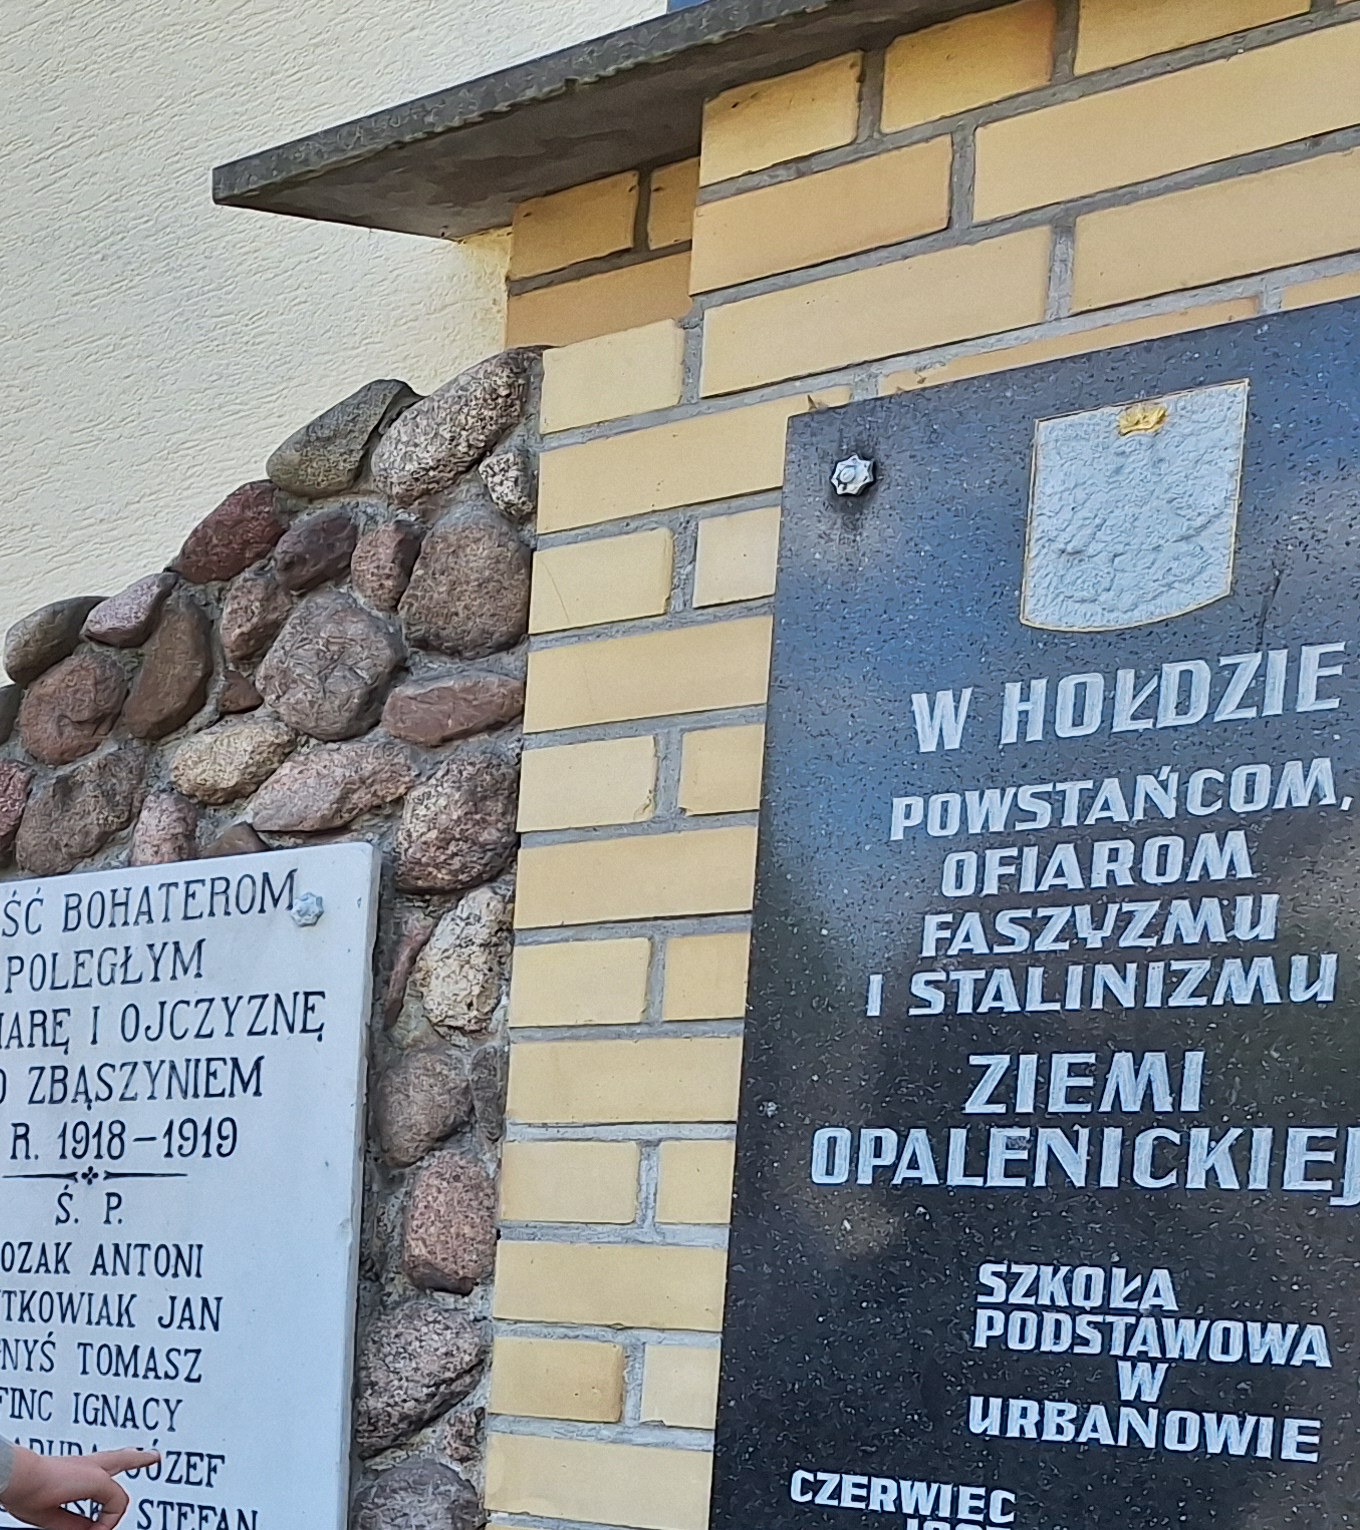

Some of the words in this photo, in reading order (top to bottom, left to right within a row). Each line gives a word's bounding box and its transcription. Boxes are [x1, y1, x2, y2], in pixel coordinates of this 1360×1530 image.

[911, 687, 974, 753] W
[1000, 641, 1346, 746] HOŁDZIE
[890, 757, 1353, 840] POWSTAŃCOM,
[940, 829, 1256, 898] OFIAROM
[63, 867, 298, 931] BOHATEROM
[920, 894, 1281, 958] FASZYZMU
[5, 938, 206, 993] POLEGŁYM
[865, 974, 883, 1017] I
[908, 953, 1338, 1017] STALINIZMU
[90, 1007, 100, 1046] I
[121, 991, 327, 1043] OJCZYZNĘ
[28, 1055, 265, 1110] ZBĄSZYNIEM
[963, 1051, 1205, 1115] ZIEMI
[10, 1122, 39, 1160] R.
[810, 1124, 1360, 1207] OPALENICKIEJ
[55, 1184, 79, 1226] Ś.
[104, 1192, 124, 1225] P.
[90, 1243, 204, 1279] ANTONI
[977, 1262, 1179, 1312] SZKOŁA
[158, 1295, 223, 1332] JAN
[974, 1308, 1333, 1368] PODSTAWOWA
[77, 1341, 203, 1384] TOMASZ
[1116, 1361, 1168, 1403] W
[72, 1393, 184, 1433] IGNACY
[968, 1395, 1321, 1463] URBANOWIE
[790, 1470, 1016, 1523] CZERWIEC
